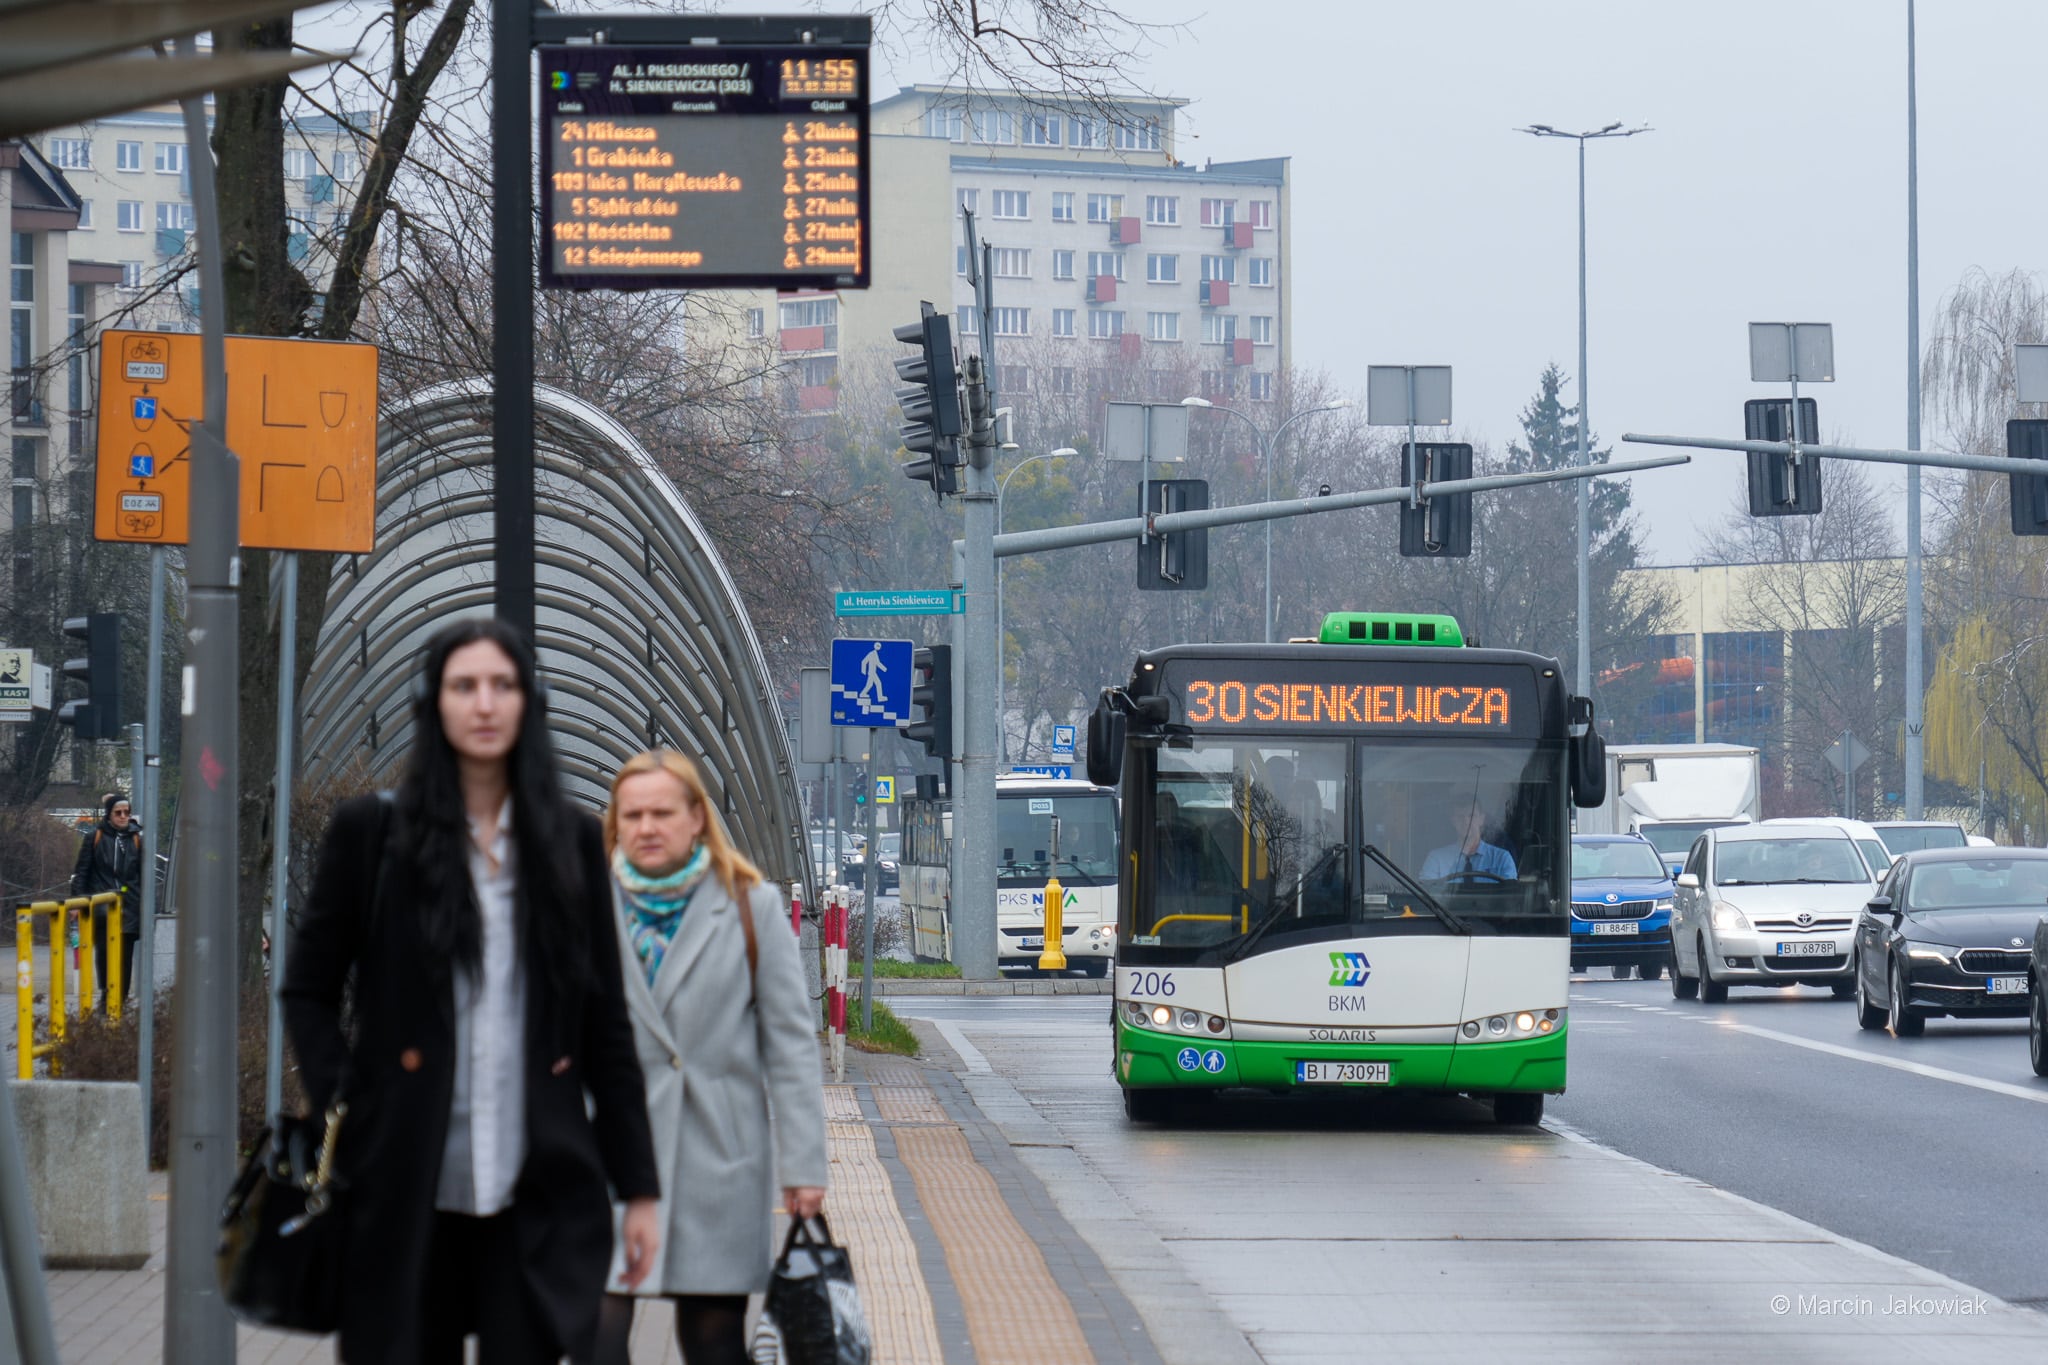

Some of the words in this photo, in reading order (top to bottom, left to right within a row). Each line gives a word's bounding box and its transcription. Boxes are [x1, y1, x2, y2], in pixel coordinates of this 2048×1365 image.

[612, 64, 633, 77] AL.
[635, 64, 645, 77] J.
[647, 64, 738, 77] PIŁSUDSKIEGO
[781, 59, 857, 80] 11:55
[609, 80, 624, 93] H.
[626, 80, 716, 93] SIENKIEWICZA
[718, 79, 753, 95] (303)
[558, 101, 583, 112] Linia
[672, 101, 716, 112] Kierunek
[811, 101, 846, 113] Odjazd
[561, 121, 584, 141] 24
[571, 147, 583, 167] 1
[586, 147, 674, 167] Grabówka
[571, 197, 584, 216] 5
[553, 222, 585, 241] 102
[587, 221, 672, 241] Kościelna
[563, 247, 585, 266] 12
[843, 597, 854, 607] ul.
[856, 597, 890, 608] Henryka
[892, 595, 945, 606] Sienkiewicza
[3, 689, 28, 697] KASY
[1187, 680, 1247, 723] 30
[1253, 684, 1508, 724] SIENKIEWICZA
[998, 893, 1028, 905] PKS
[1595, 924, 1606, 933] BI
[1609, 923, 1637, 933] 884FE
[1784, 944, 1797, 954] BI
[1802, 943, 1833, 954] 6878P
[1129, 971, 1176, 997] 206
[1995, 979, 2008, 991] BI
[2015, 978, 2029, 990] 75
[1328, 995, 1366, 1012] BKM
[1309, 1029, 1377, 1042] SOLARIS
[1307, 1064, 1327, 1080] BI
[1336, 1064, 1386, 1081] 7309H
